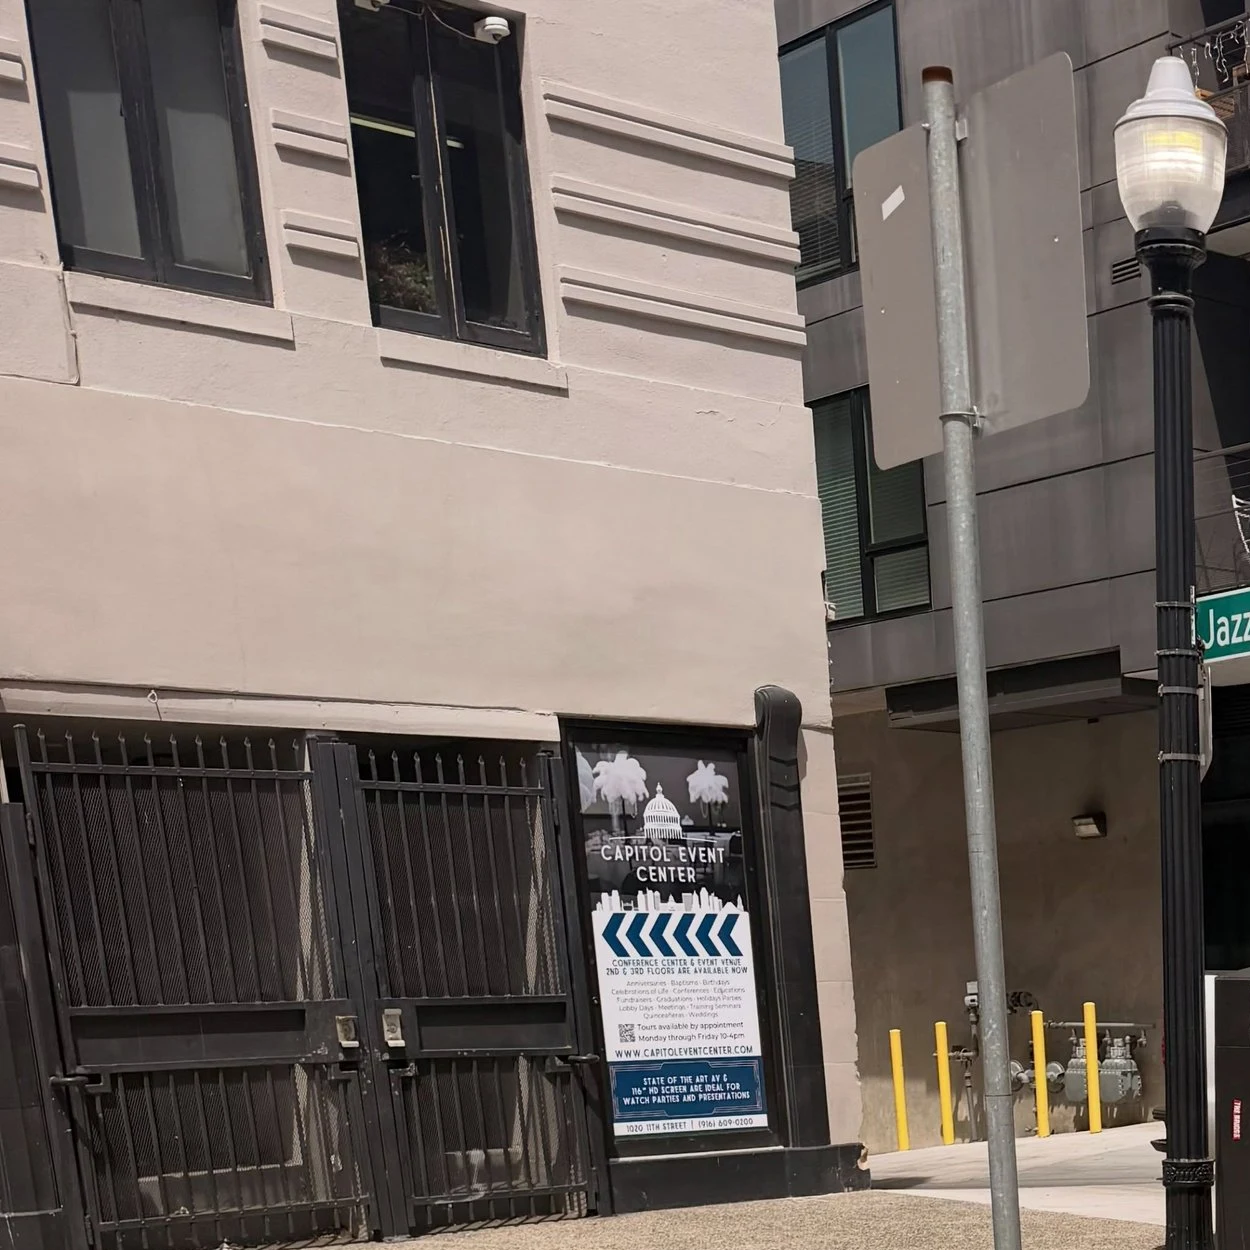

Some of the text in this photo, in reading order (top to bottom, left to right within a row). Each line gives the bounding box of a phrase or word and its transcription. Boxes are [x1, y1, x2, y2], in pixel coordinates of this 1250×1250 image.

[601, 845, 725, 864] CAPITOL EVENT
[636, 865, 696, 883] CENTER
[612, 959, 658, 967] CONFERENCE
[606, 968, 619, 976] 2ND
[647, 967, 675, 975] FLOORS
[732, 966, 748, 974] NOW
[637, 1023, 657, 1031] Tours
[700, 1021, 744, 1030] appointment
[615, 1045, 753, 1058] WWW.CAPITOLEVENTCENTER.COM
[643, 1077, 665, 1086] STATE
[667, 1076, 678, 1084] OF
[680, 1076, 693, 1084] THE
[695, 1075, 708, 1083] ART
[649, 1087, 659, 1095] HD
[661, 1085, 687, 1094] SCREEN
[690, 1084, 704, 1092] ARE
[705, 1083, 724, 1092] IDEAL
[726, 1082, 741, 1091] FOR
[622, 1091, 750, 1106] WATCH PARTIES AND PRESENTATIONS
[626, 1124, 644, 1132] 1020
[646, 1123, 660, 1131] 11TH
[662, 1122, 687, 1130] STREET
